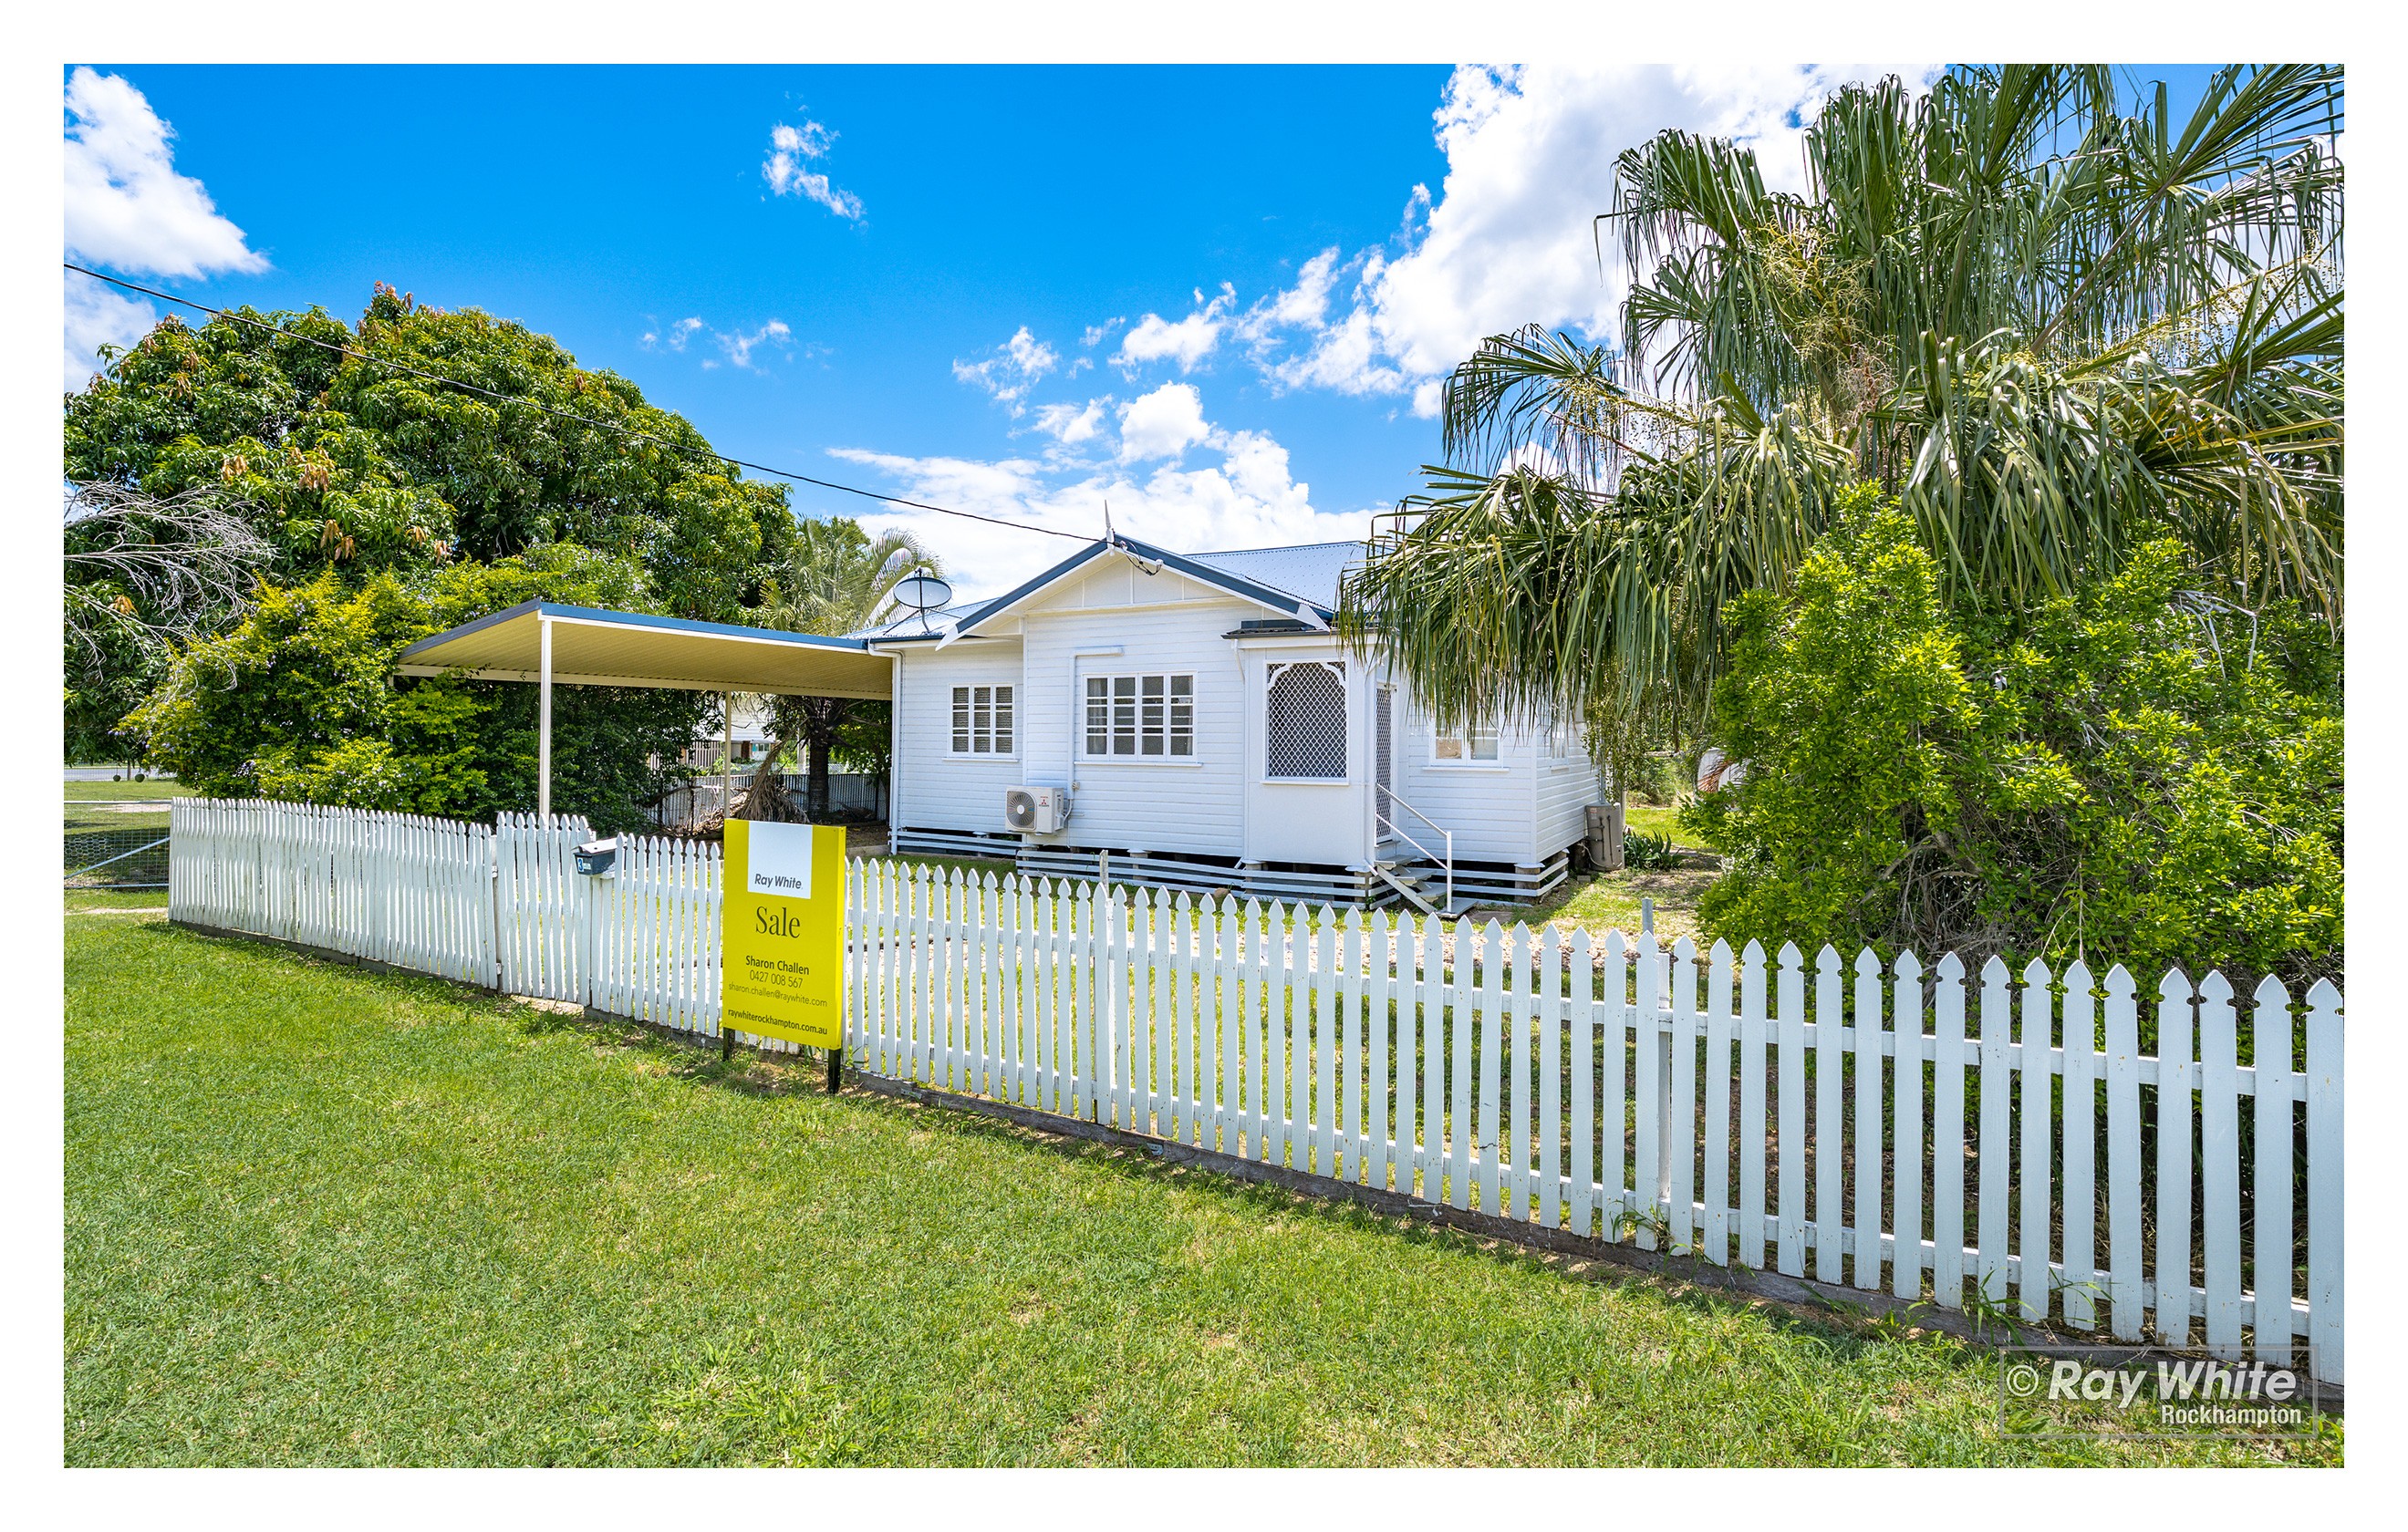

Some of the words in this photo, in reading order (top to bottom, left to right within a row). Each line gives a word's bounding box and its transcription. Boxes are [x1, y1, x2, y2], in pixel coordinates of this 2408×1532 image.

[754, 873, 773, 888] Ray
[774, 875, 803, 890] White
[755, 906, 801, 938] Sale
[745, 955, 775, 969] Sharon
[777, 960, 810, 975] Challen
[749, 969, 769, 983] 0427
[771, 973, 786, 986] 008
[788, 976, 804, 989] 567
[728, 981, 828, 1007] sharon.challen@raywhite.com
[727, 1009, 828, 1035] raywhiterockhampton.com.au
